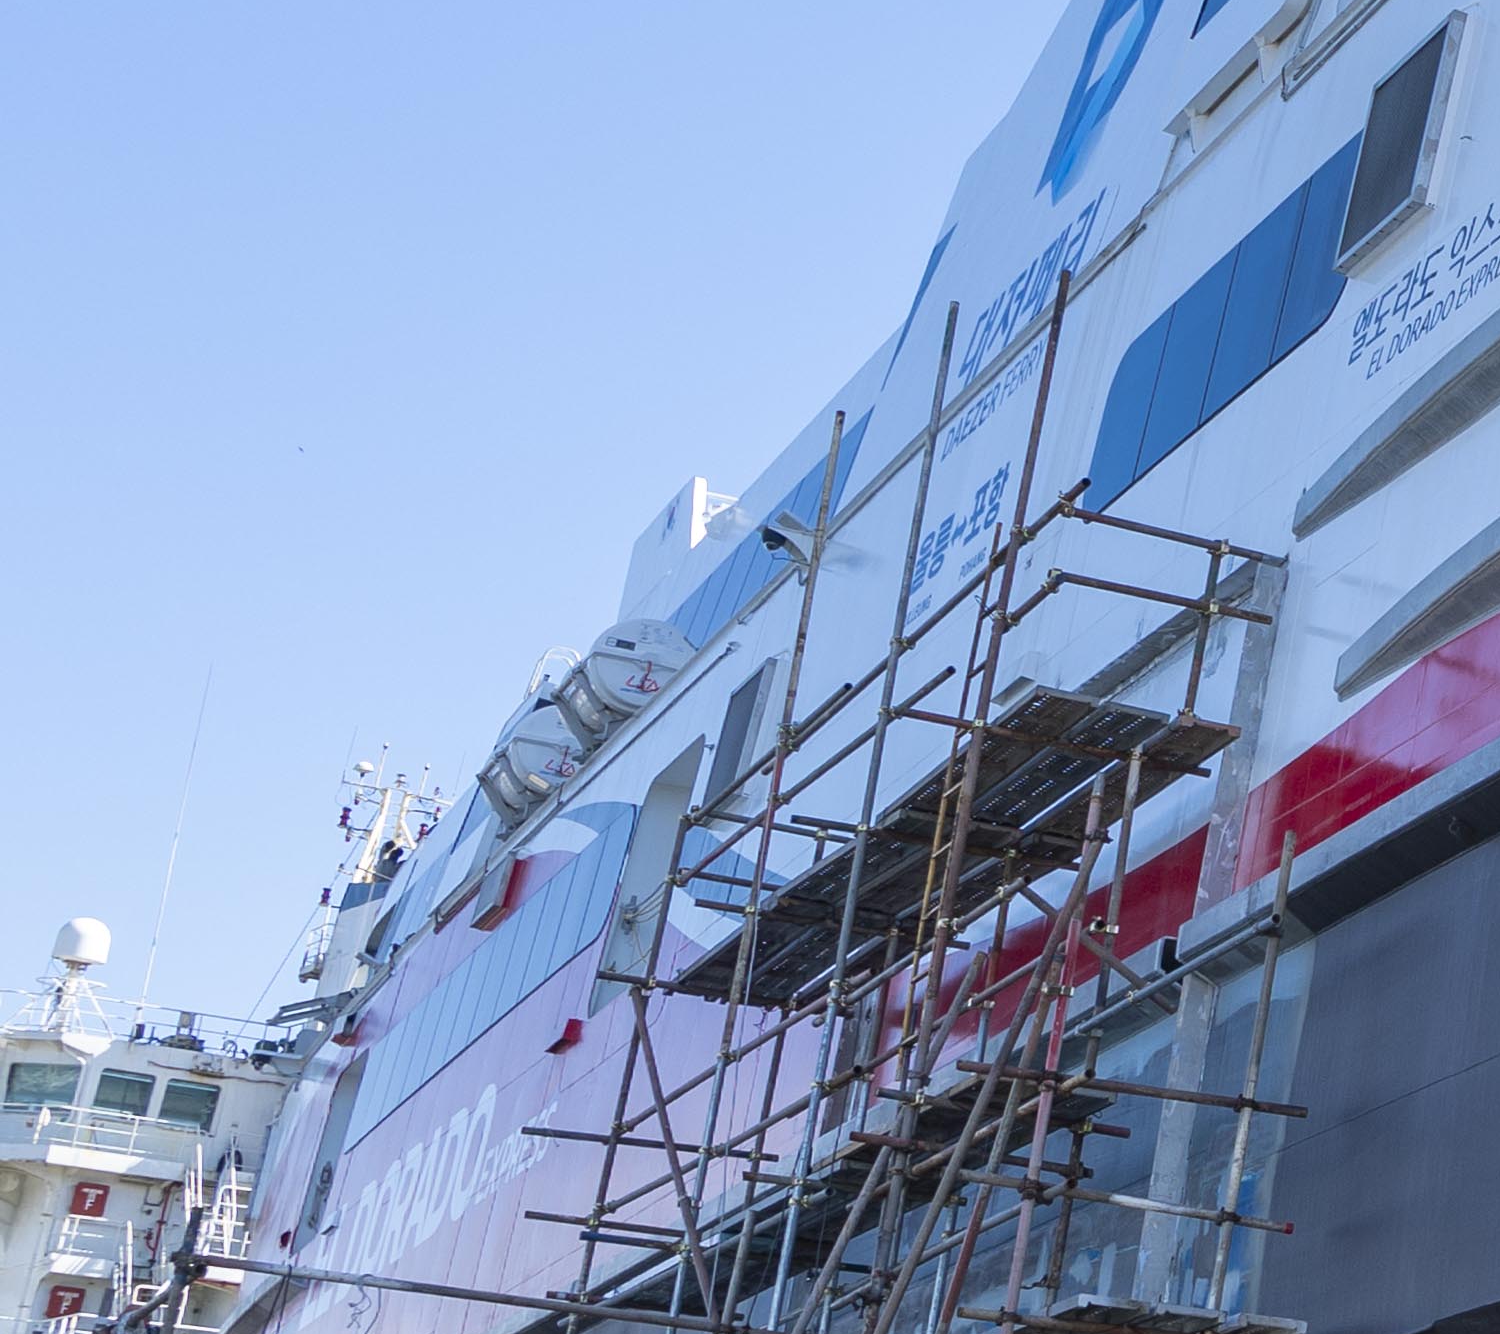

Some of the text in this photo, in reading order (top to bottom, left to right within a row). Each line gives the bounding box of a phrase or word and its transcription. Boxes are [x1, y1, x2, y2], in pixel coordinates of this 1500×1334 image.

[958, 187, 1107, 388] 대저페리
[1348, 245, 1445, 366] 엘도라도
[1366, 347, 1383, 380] EL
[1386, 290, 1455, 364] DORADO
[941, 337, 1048, 462] DAEZER FERRY
[335, 1083, 497, 1305] DORADO
[474, 1101, 558, 1205] EXPRESS
